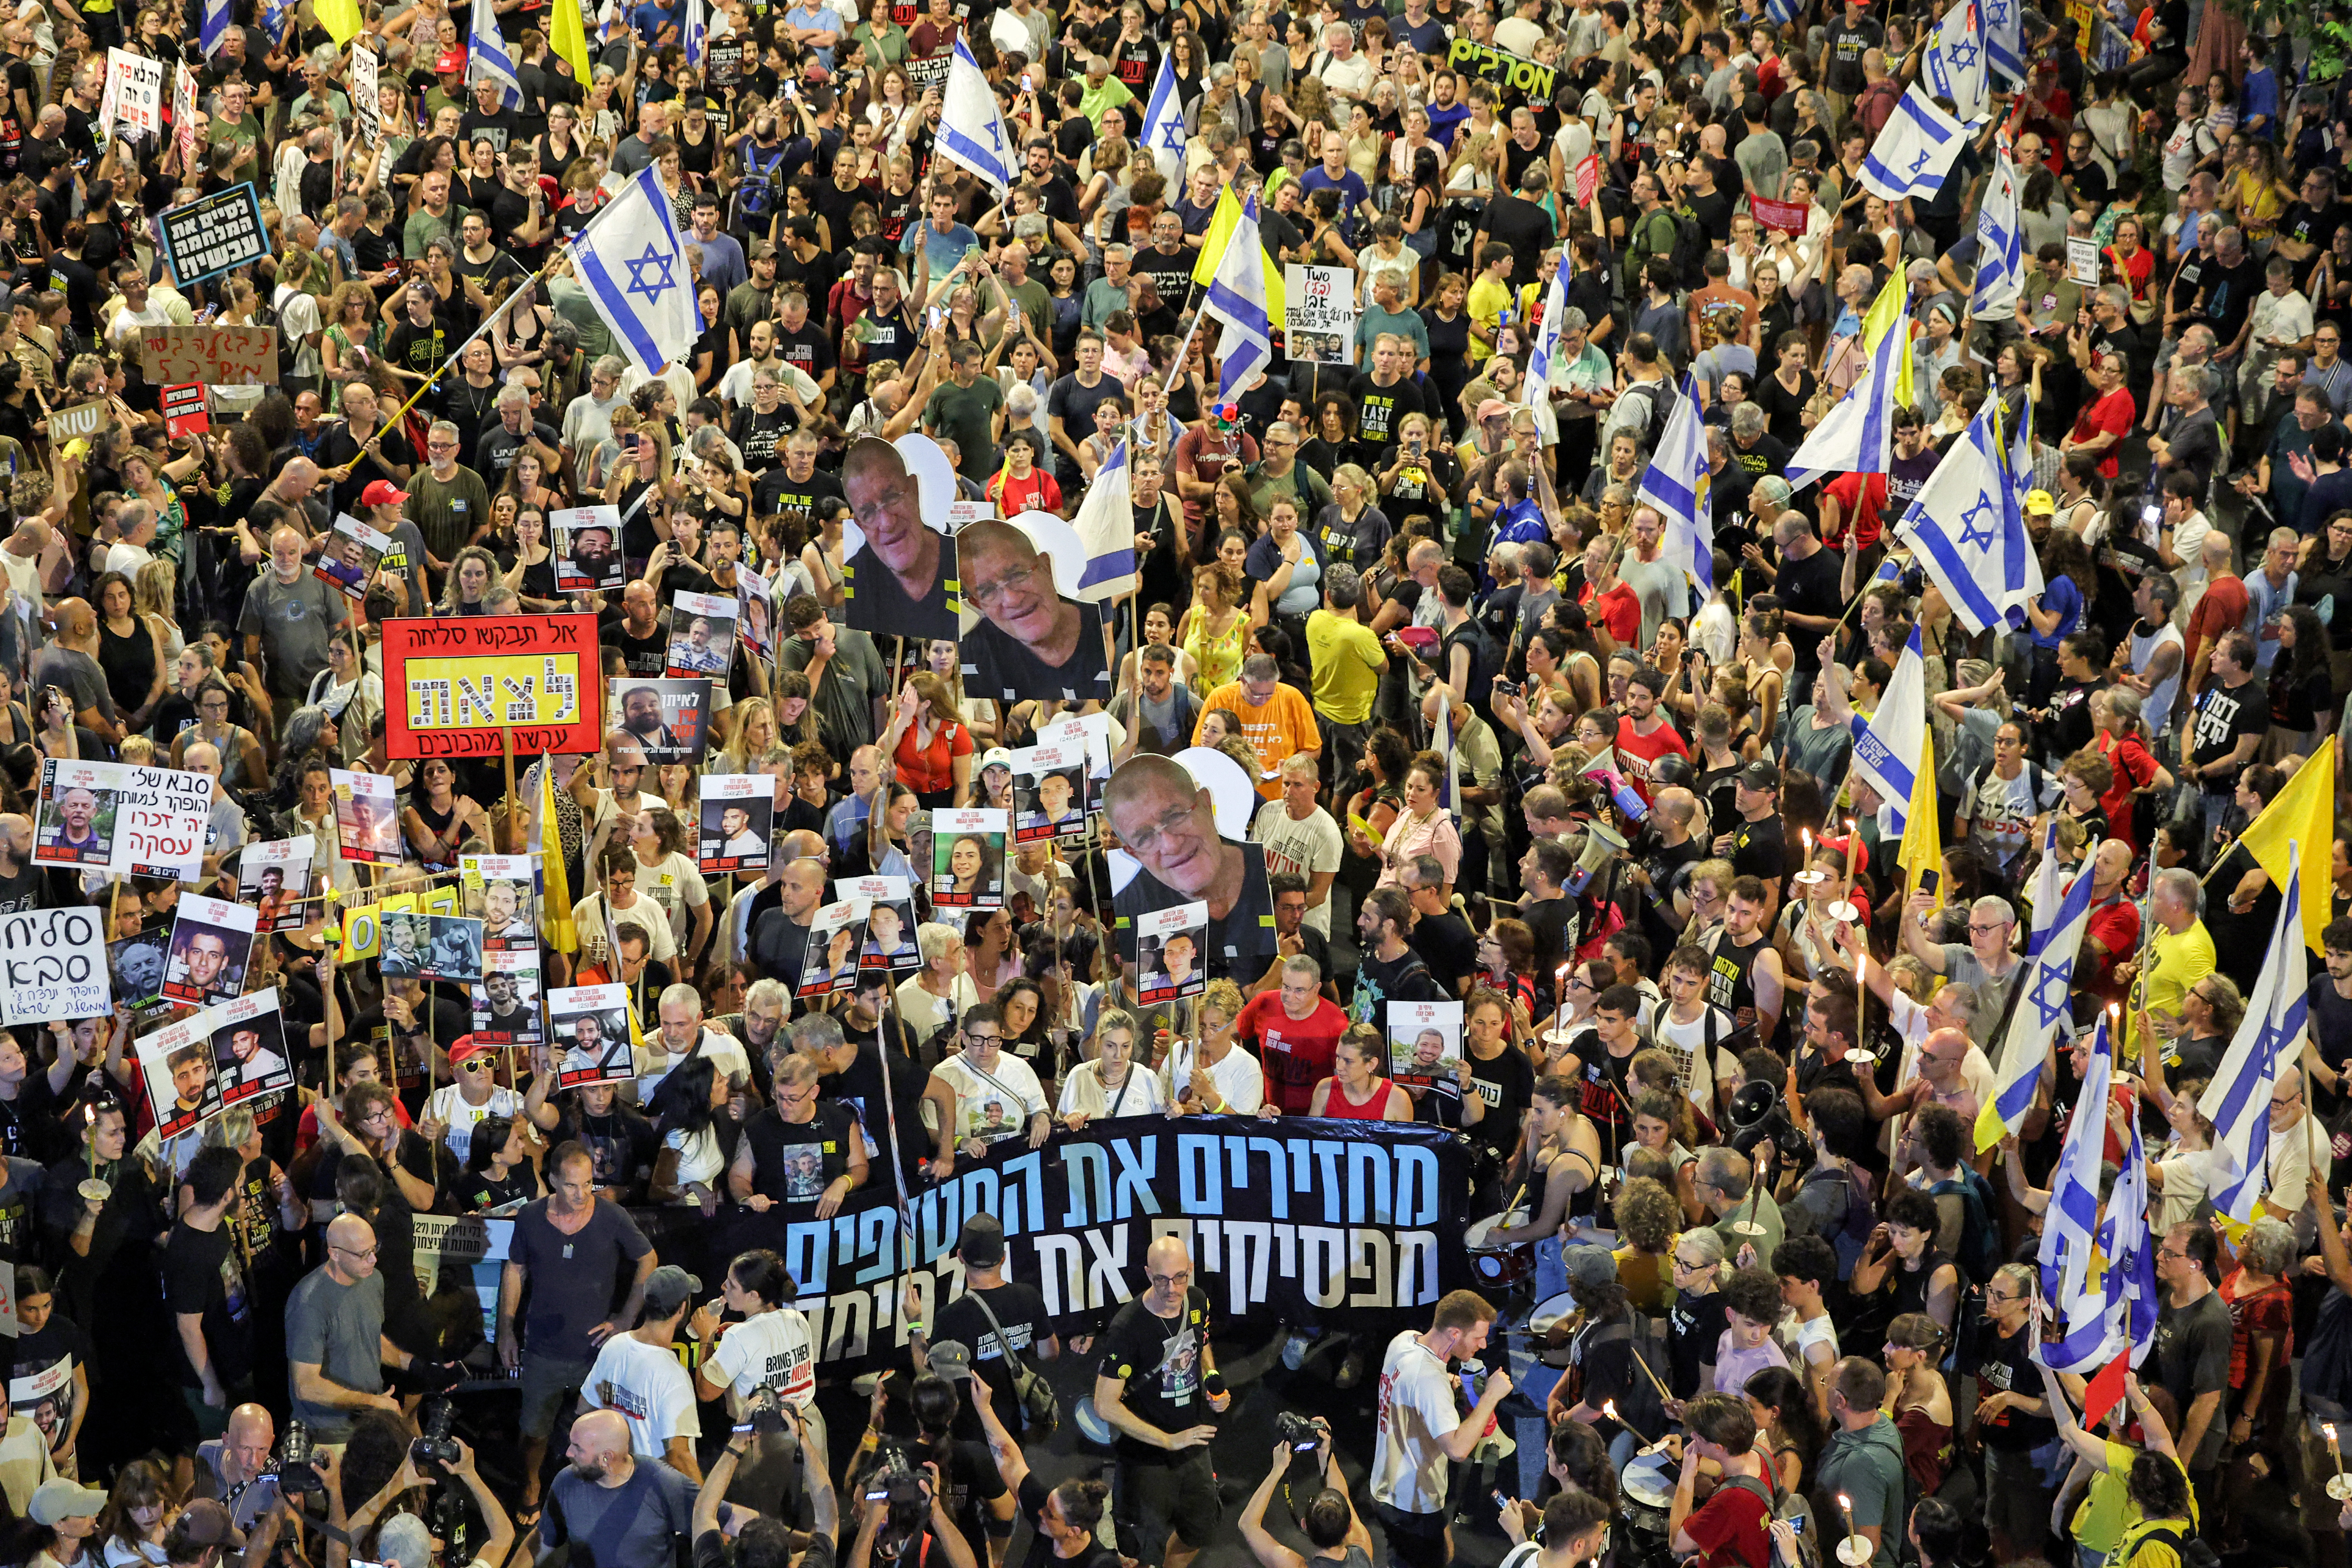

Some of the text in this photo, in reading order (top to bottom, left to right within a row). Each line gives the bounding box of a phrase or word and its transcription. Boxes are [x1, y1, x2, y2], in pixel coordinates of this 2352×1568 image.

[906, 56, 951, 71] הכיבוש
[134, 61, 145, 82] לא
[148, 71, 159, 87] זה
[125, 87, 137, 102] זה
[170, 198, 249, 240] לסיים את
[174, 215, 254, 257] המלחמה
[178, 233, 260, 280] עכשיו!
[1381, 397, 1394, 408] THE
[1362, 404, 1392, 421] LAST
[779, 493, 812, 506] UNTIL THE
[558, 561, 576, 570] BRING
[558, 569, 571, 578] HIM
[407, 618, 577, 649] אל תבקשו סליחה
[410, 657, 576, 725] לצאת
[661, 693, 700, 709] לאיתן
[678, 709, 697, 722] אין
[670, 724, 697, 739] זמן!
[511, 728, 568, 753] עכשיו
[131, 768, 209, 795] סבא שלי
[118, 790, 209, 813] הופקר למוות
[131, 811, 173, 829] זכרו
[1016, 810, 1036, 821] BRING
[1016, 819, 1029, 830] HIM
[40, 826, 61, 837] BRING
[1017, 824, 1054, 839] HOME NOW!
[38, 835, 53, 845] HIM
[129, 832, 192, 859] עסקה
[701, 838, 720, 849] BRING
[701, 849, 713, 859] HIM
[464, 859, 477, 869] 673
[701, 857, 738, 869] HOME NOW!
[148, 866, 162, 877] פרי
[162, 868, 180, 878] חיים
[934, 874, 954, 884] BRING
[648, 887, 671, 897] מחזירים
[933, 892, 972, 903] HOME NOW!
[6, 955, 91, 988] סבא
[168, 962, 190, 975] BRING
[804, 967, 821, 978] BRING
[166, 971, 181, 984] HIM
[802, 976, 814, 986] HIM
[1140, 971, 1159, 983] BRING
[66, 985, 100, 997] הופקר
[1139, 981, 1152, 992] HIM
[29, 987, 59, 1001] ונרצח
[1140, 987, 1177, 1001] HOME NOW!
[10, 999, 106, 1020] ממשלת ישראל!
[472, 1011, 492, 1021] BRING
[473, 1021, 486, 1031] HIM
[474, 1030, 511, 1042] HOME NOW!
[1267, 1029, 1282, 1041] BRING
[1265, 1037, 1292, 1053] THEM HOME
[559, 1062, 573, 1073] HIM
[1392, 1060, 1412, 1069] BRING
[220, 1065, 237, 1079] BRING
[561, 1067, 601, 1083] HOME NOW!
[221, 1078, 232, 1091] HIM
[1393, 1074, 1432, 1086] HOME NOW!
[157, 1100, 176, 1115] BRING
[158, 1112, 172, 1126] HIM
[980, 1134, 1009, 1145] BRING ITAY
[786, 1133, 1439, 1296] מחזירים את החטופים
[1035, 1223, 1133, 1316] את
[797, 1243, 1012, 1364] לחימה
[766, 1343, 809, 1373] BRING THEM
[766, 1359, 811, 1388] HOME NOW!
[1175, 1387, 1190, 1397] MATAN
[1175, 1394, 1191, 1408] NOW!
